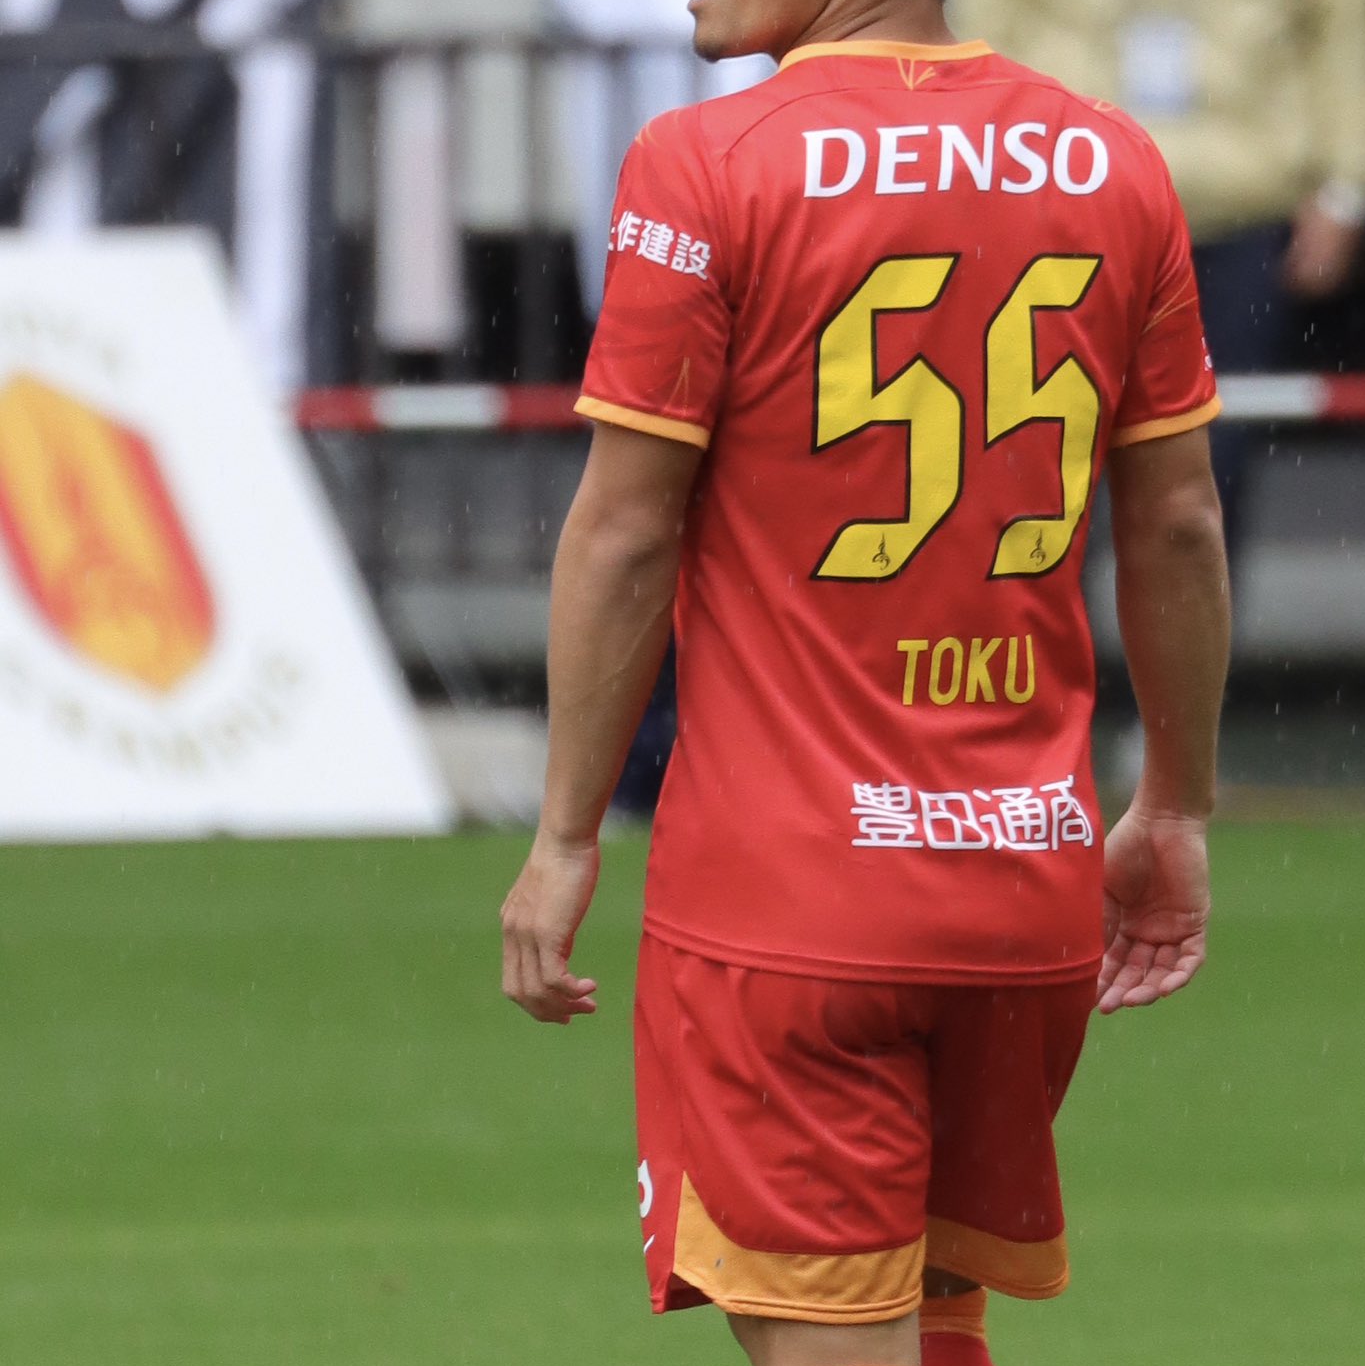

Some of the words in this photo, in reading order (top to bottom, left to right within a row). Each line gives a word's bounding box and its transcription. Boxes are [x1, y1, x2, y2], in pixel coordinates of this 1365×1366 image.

[803, 122, 1109, 199] DENSO
[607, 210, 712, 282] 作建設
[810, 252, 1103, 582] 55
[896, 634, 1036, 706] TOKU
[850, 774, 1094, 851] 豊田通商
